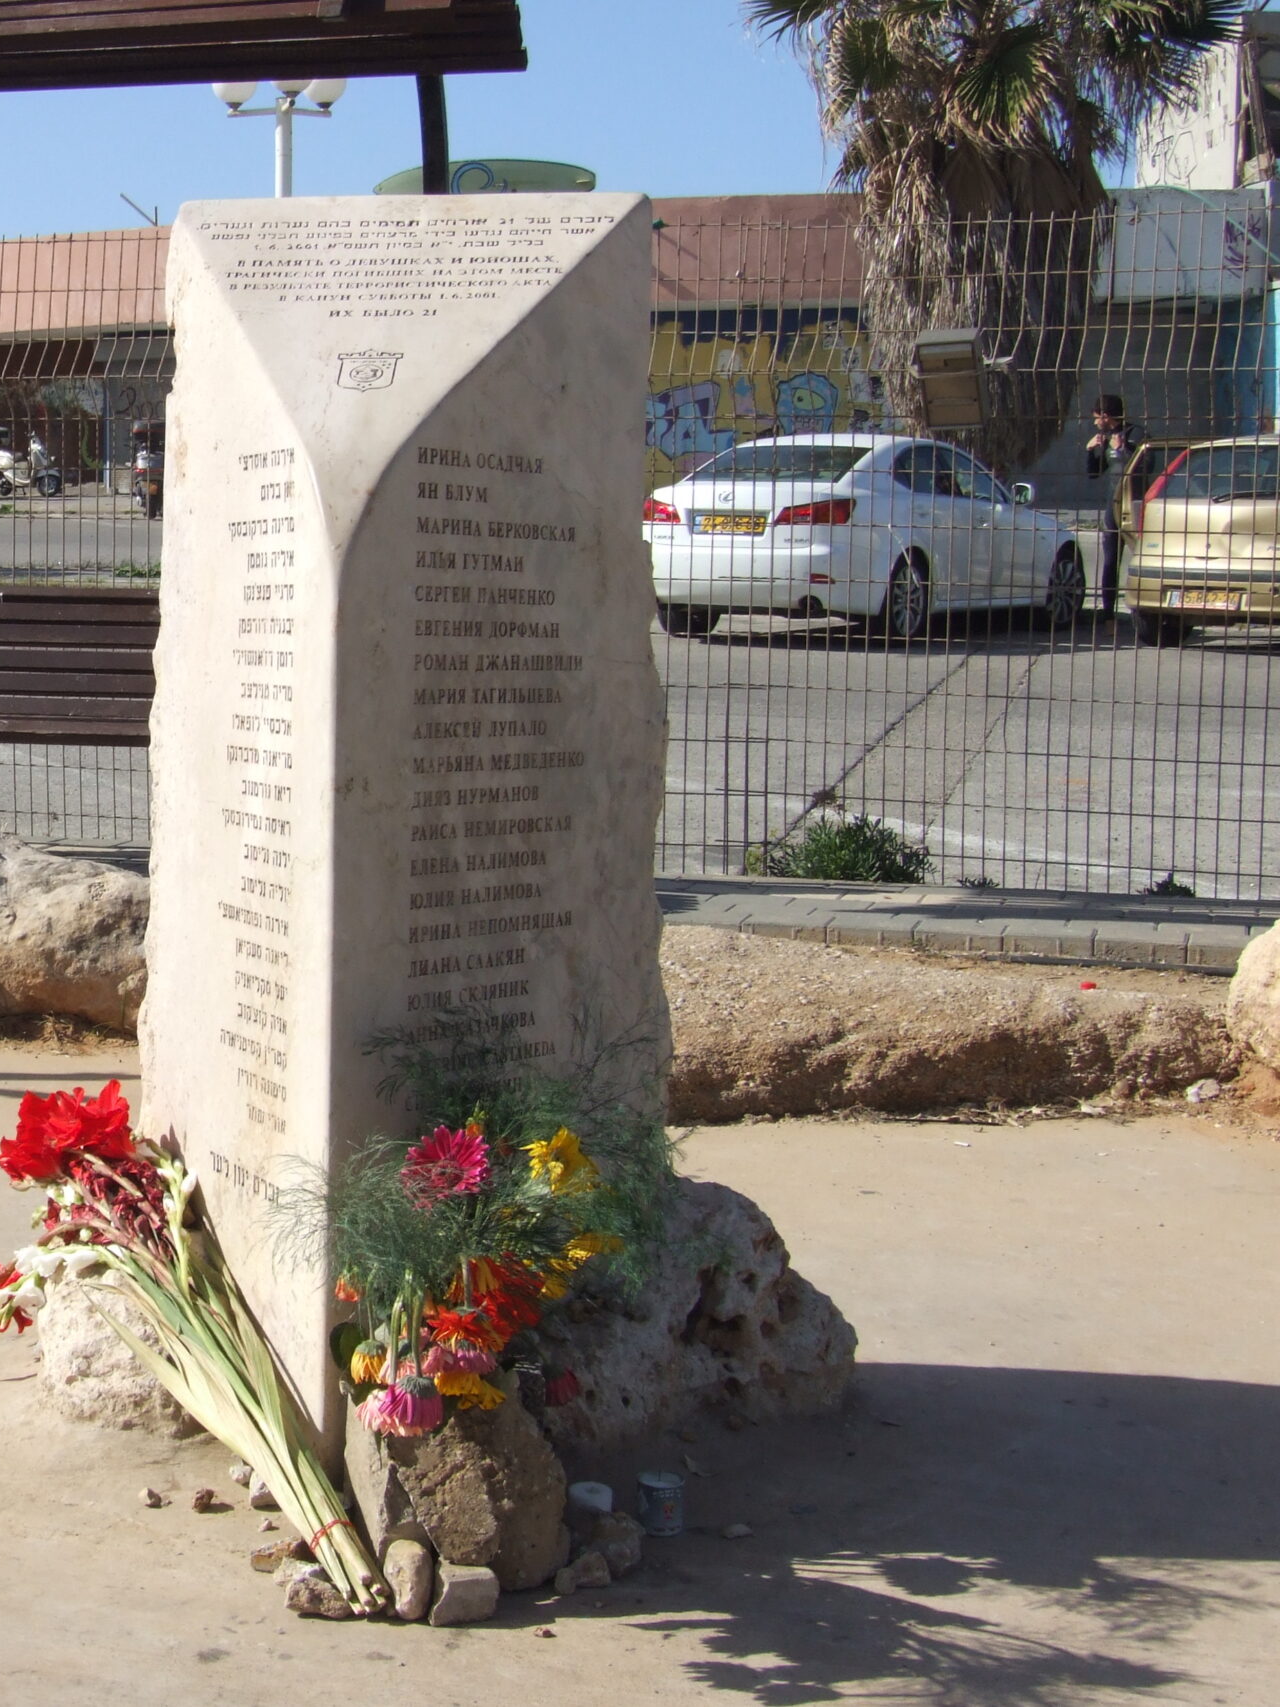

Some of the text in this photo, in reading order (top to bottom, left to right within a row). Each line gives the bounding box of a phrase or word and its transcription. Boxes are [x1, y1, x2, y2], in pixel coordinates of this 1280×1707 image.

[317, 220, 351, 228] בהם
[359, 219, 419, 228] תמימים
[224, 266, 563, 279] ТРАГИЧЕСКИ ПОГИБШИХ НА ЭТОМ МЕСТЕ
[252, 259, 323, 268] ПАМЯТЬ
[329, 259, 340, 267] О
[345, 257, 445, 267] ДЕВУШКАХ
[243, 282, 331, 291] РЕЗУЛЬТАТЕ
[337, 279, 508, 290] ТЕРРОРИСТИЧЕСКОГО
[295, 294, 351, 302] КАНУН
[358, 293, 432, 301] СУББОТЫ
[328, 310, 353, 318] ИХ
[362, 309, 414, 318] БЫЛО
[417, 447, 544, 474] ИРИНА ОСАДЧАЯ
[417, 482, 488, 503] ЯН БЛУМ
[416, 516, 577, 543] МАРИНА БЕРКОВСКАЯ
[415, 551, 524, 573] ИЛЬЯ ГУТМАН
[477, 586, 556, 606] ПАНЧЕНКО
[414, 619, 561, 639] ЕВГЕНИЯ ДОРФМАН
[413, 654, 583, 673] РОМАН ДЖАНАШВИЛИ
[413, 687, 562, 705] МАРИЯ ТАГИЛЬЦЕВА
[488, 719, 548, 738] ЛУПАЛО
[413, 751, 585, 775] МАРЬЯНА МЕДВЕДЕНКО
[411, 786, 539, 810] ДИЯЗ НУРМАНОВ
[411, 815, 572, 842] РАИСА НЕМИРОВСКАЯ
[410, 849, 547, 877] ЕЛЕНА НАЛИМОВА
[409, 883, 542, 910] ЮЛИЯ НАЛИМОВА
[408, 910, 573, 944] ИРИНА НЕПОМНЯЩАЯ
[407, 947, 526, 978] ЛИАНА СААКЯН
[407, 979, 529, 1012] ЮЛИЯ СКЛЯНИК
